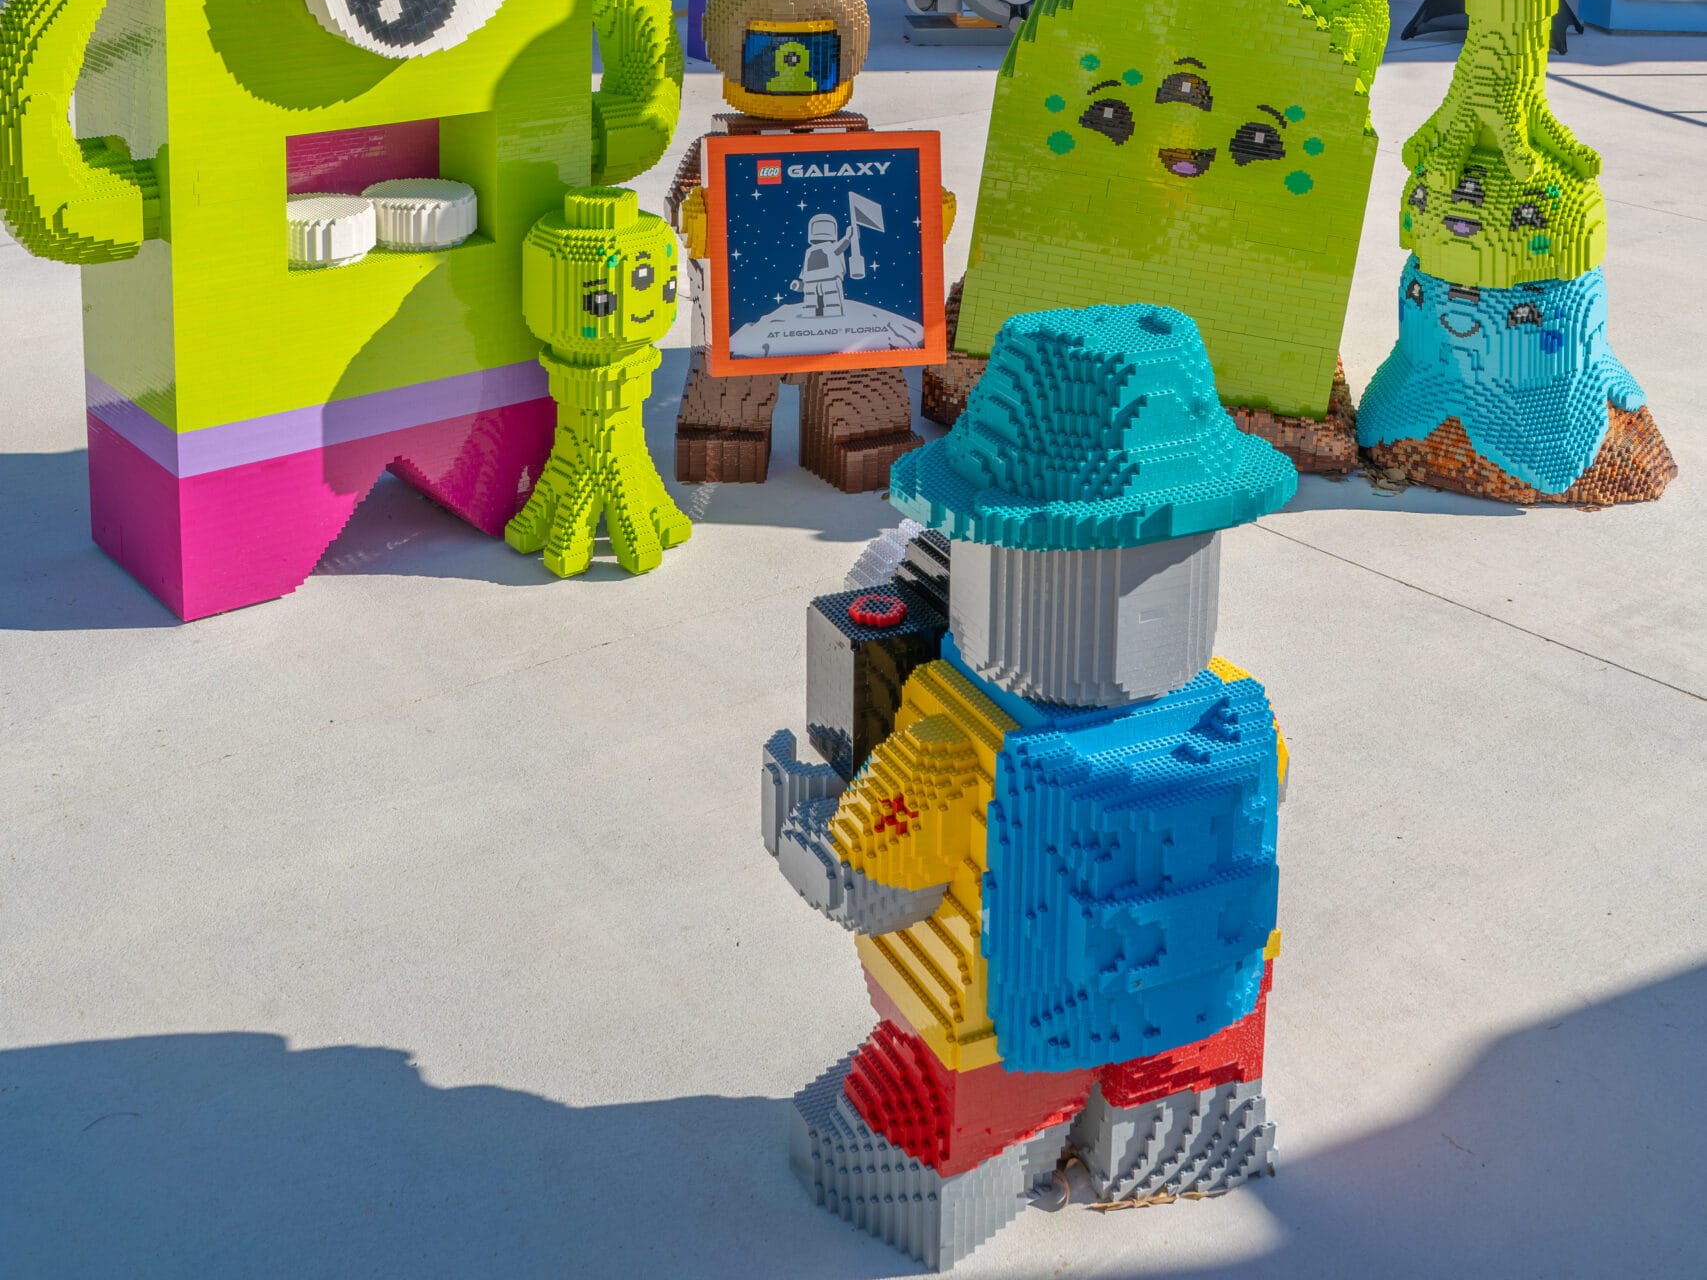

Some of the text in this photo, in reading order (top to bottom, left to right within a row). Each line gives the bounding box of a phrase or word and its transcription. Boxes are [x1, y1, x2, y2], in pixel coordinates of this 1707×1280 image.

[759, 162, 891, 178] LEGO GALAXY
[767, 331, 781, 339] AT
[844, 325, 889, 334] FLORIDA
